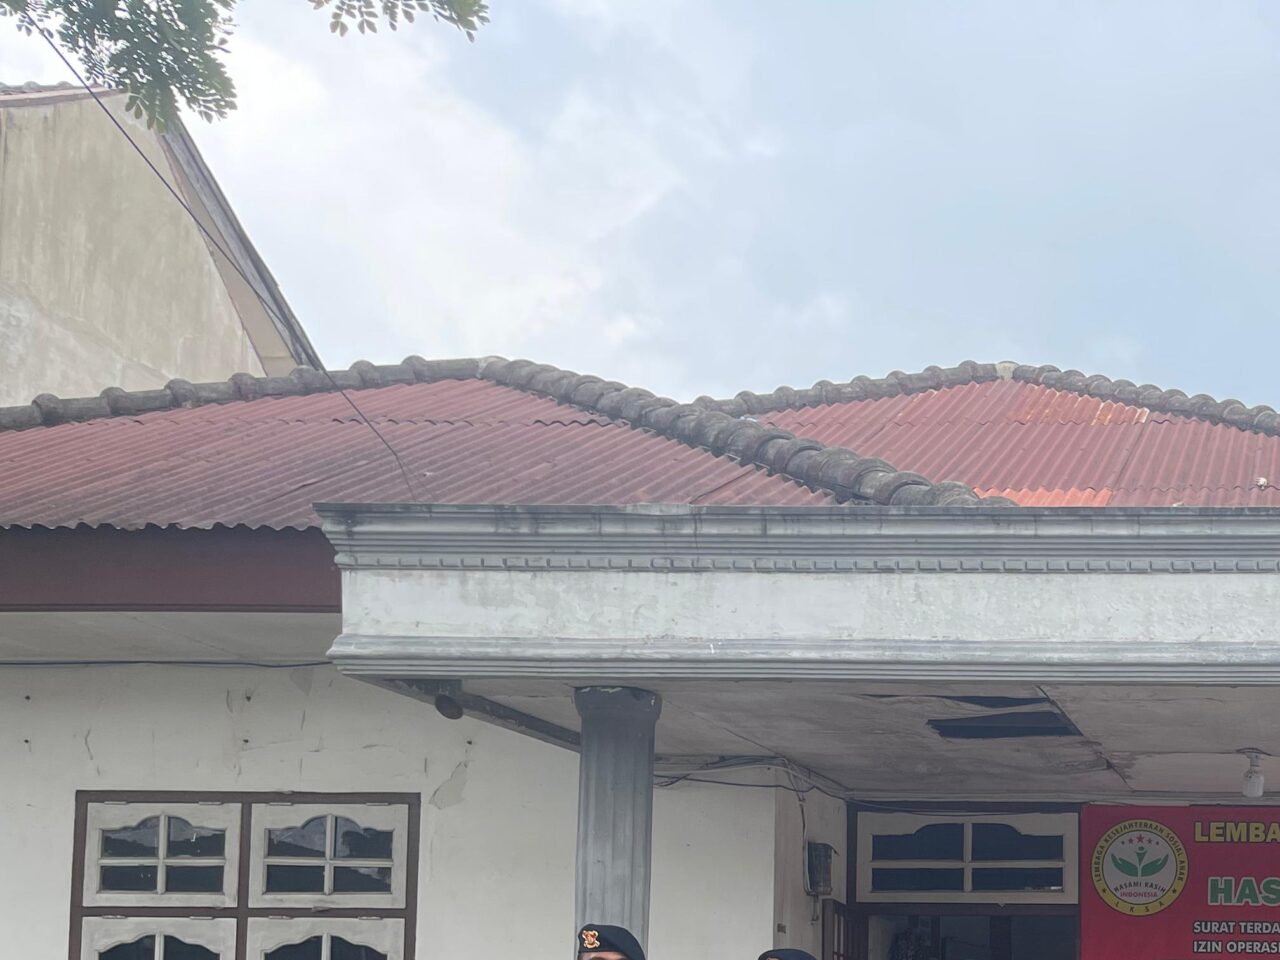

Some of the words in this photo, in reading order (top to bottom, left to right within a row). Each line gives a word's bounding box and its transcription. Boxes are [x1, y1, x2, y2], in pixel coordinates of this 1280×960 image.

[1113, 881, 1142, 892] HASAMI
[1144, 881, 1167, 893] KASIH
[1193, 921, 1236, 933] SURAT
[1193, 940, 1222, 953] IZIN
